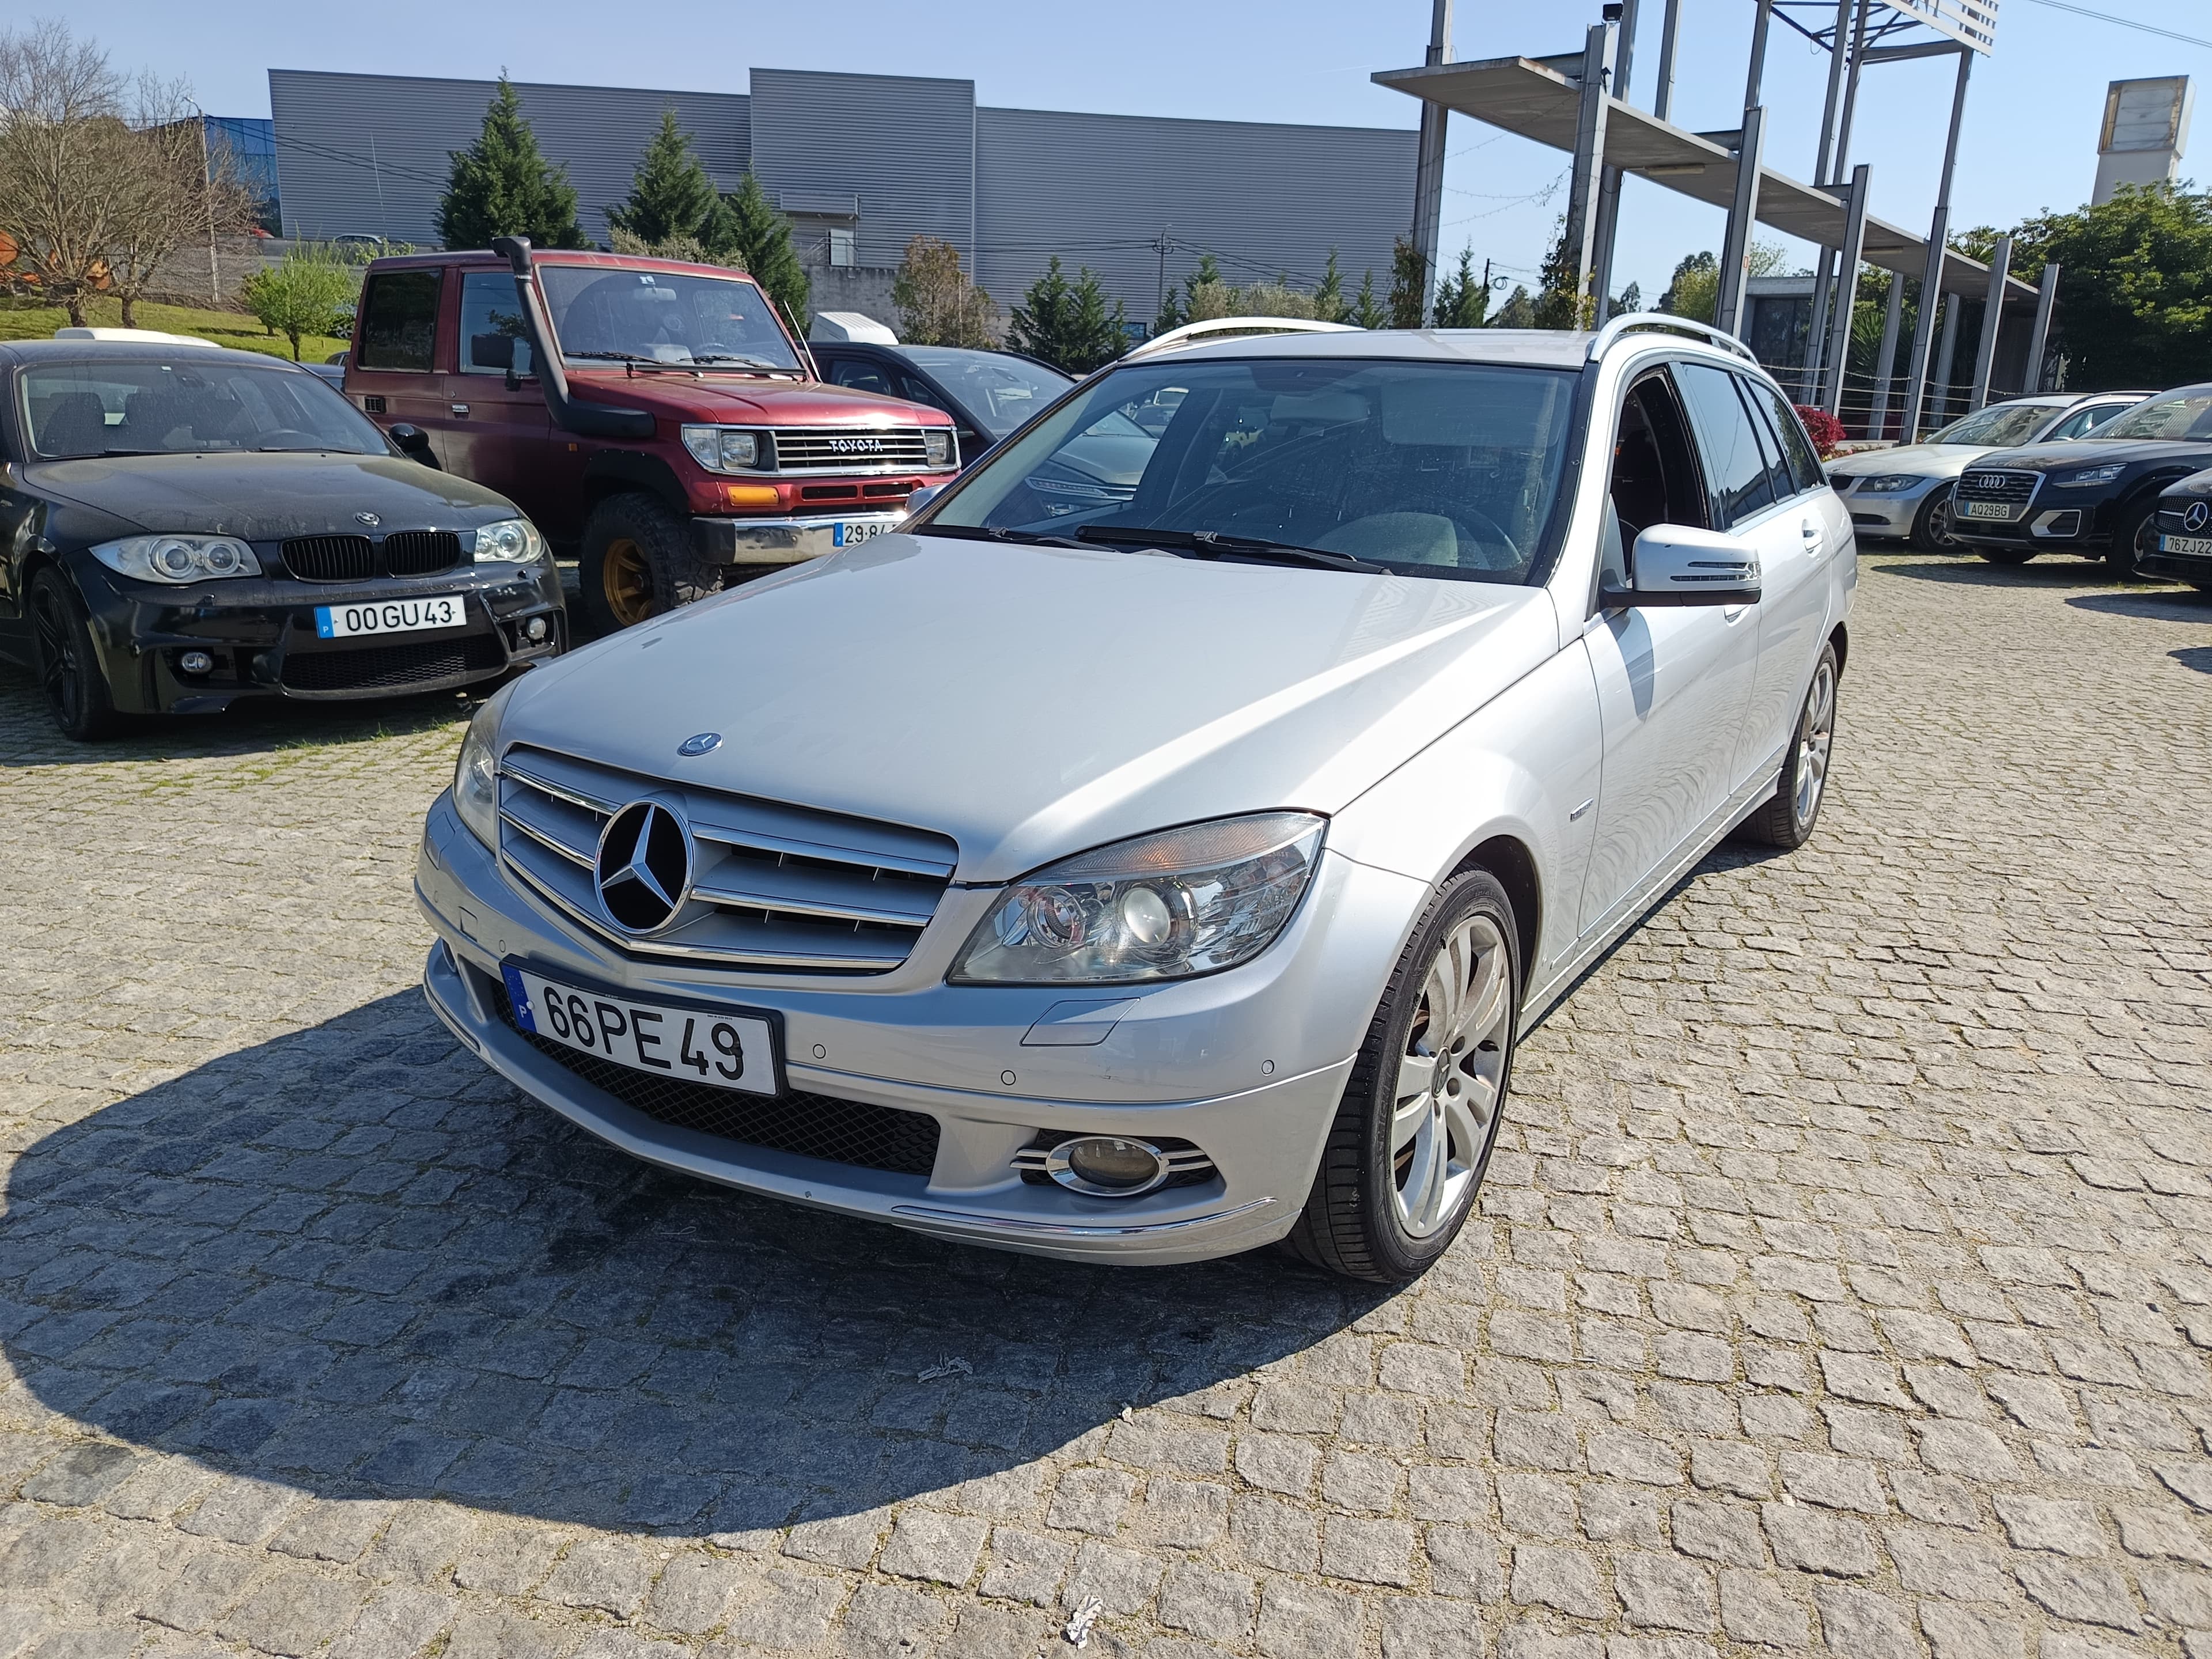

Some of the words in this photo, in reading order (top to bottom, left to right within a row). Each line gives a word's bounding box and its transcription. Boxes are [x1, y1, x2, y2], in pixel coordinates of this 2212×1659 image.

[829, 440, 883, 452] TOYOTA
[1971, 504, 2007, 517] AQ29BG
[2169, 537, 2212, 554] 76ZJ22
[346, 601, 452, 632] 00GU43
[518, 1004, 527, 1018] P
[543, 986, 745, 1081] 66PE49
